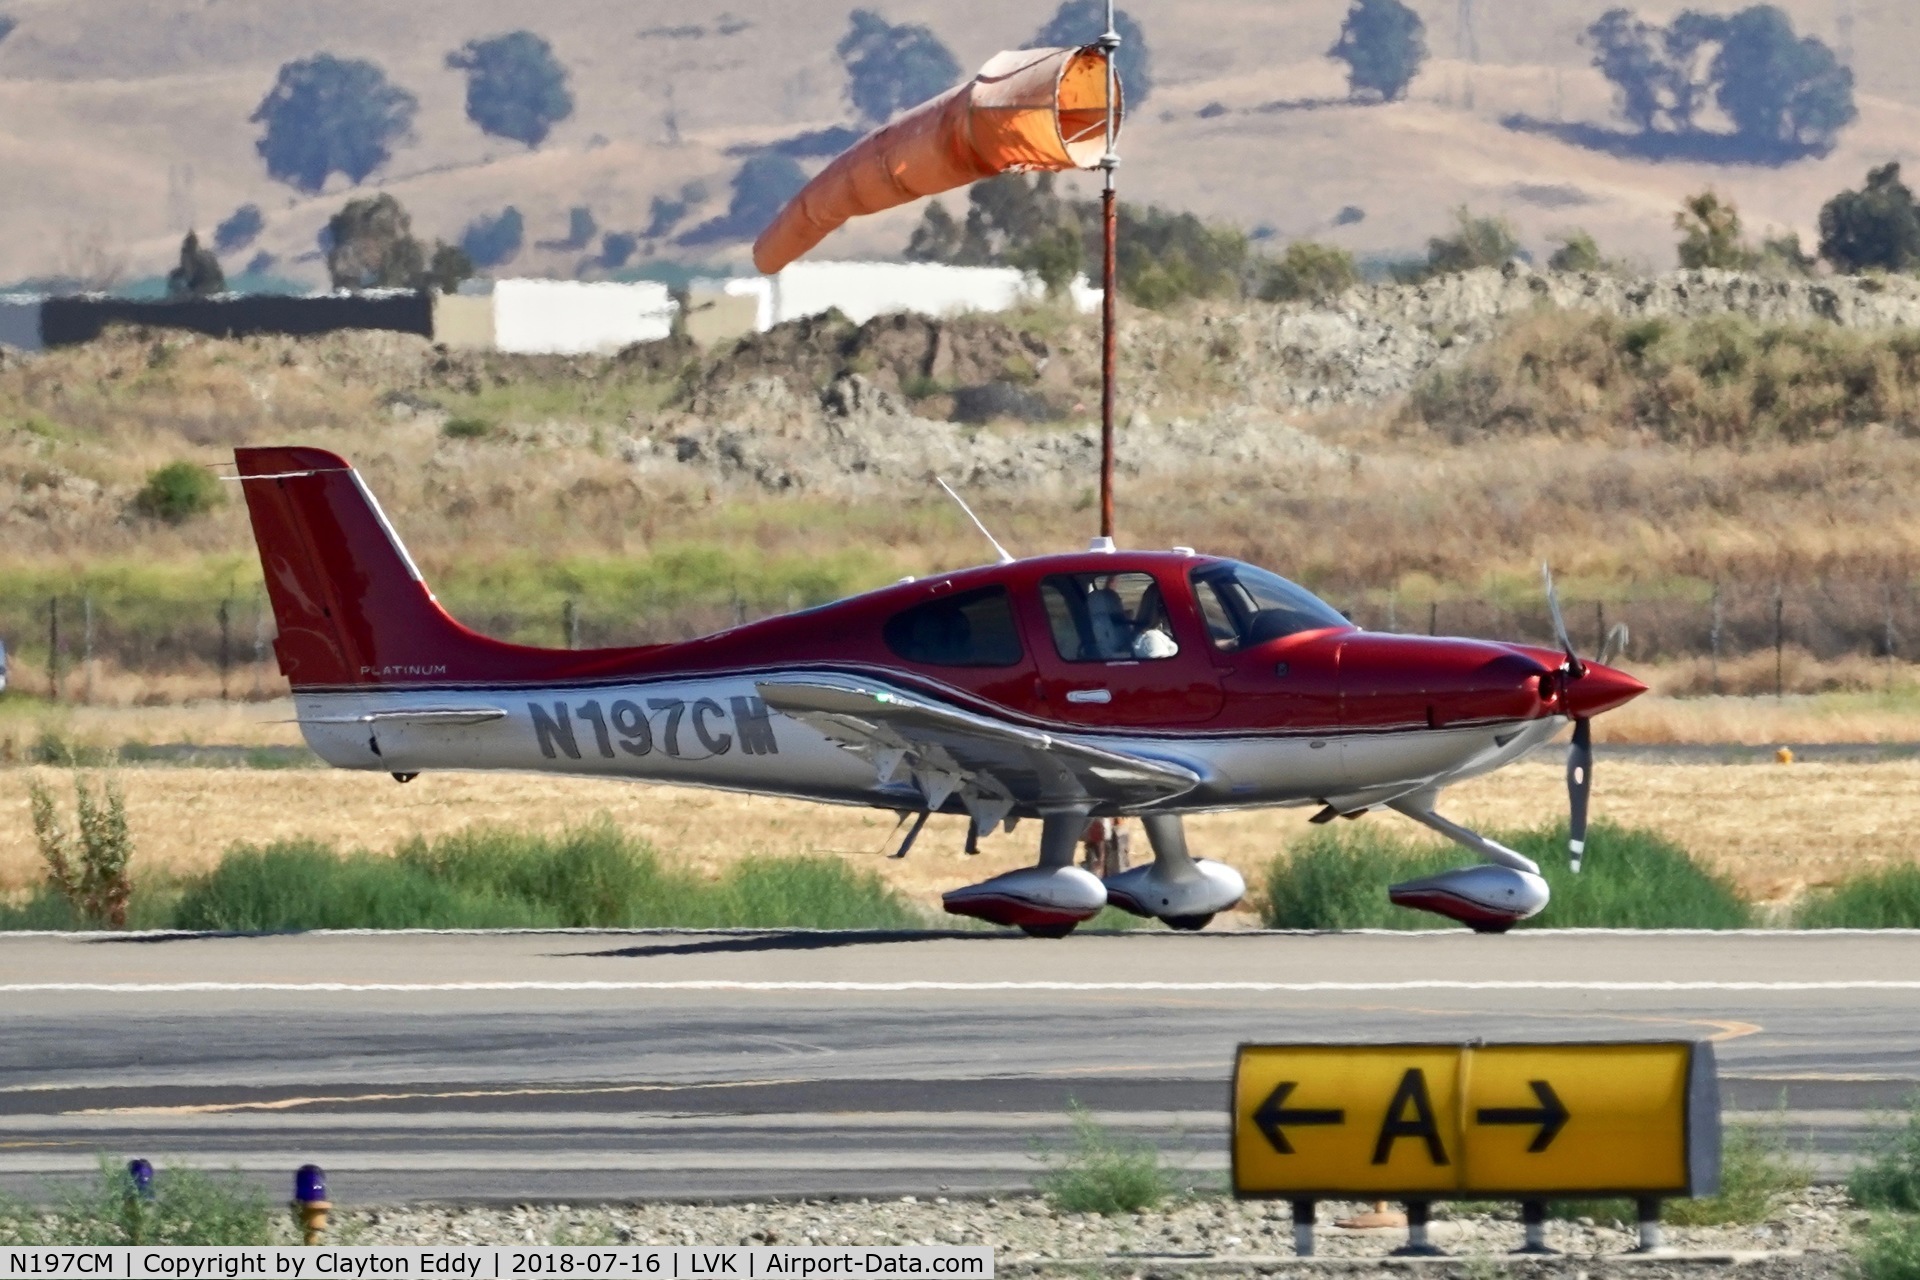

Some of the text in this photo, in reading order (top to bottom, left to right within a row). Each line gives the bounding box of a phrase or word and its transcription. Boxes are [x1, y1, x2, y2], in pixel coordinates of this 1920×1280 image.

[360, 665, 447, 676] PLATINUM
[527, 696, 779, 760] N197CM
[1371, 1068, 1450, 1165] A
